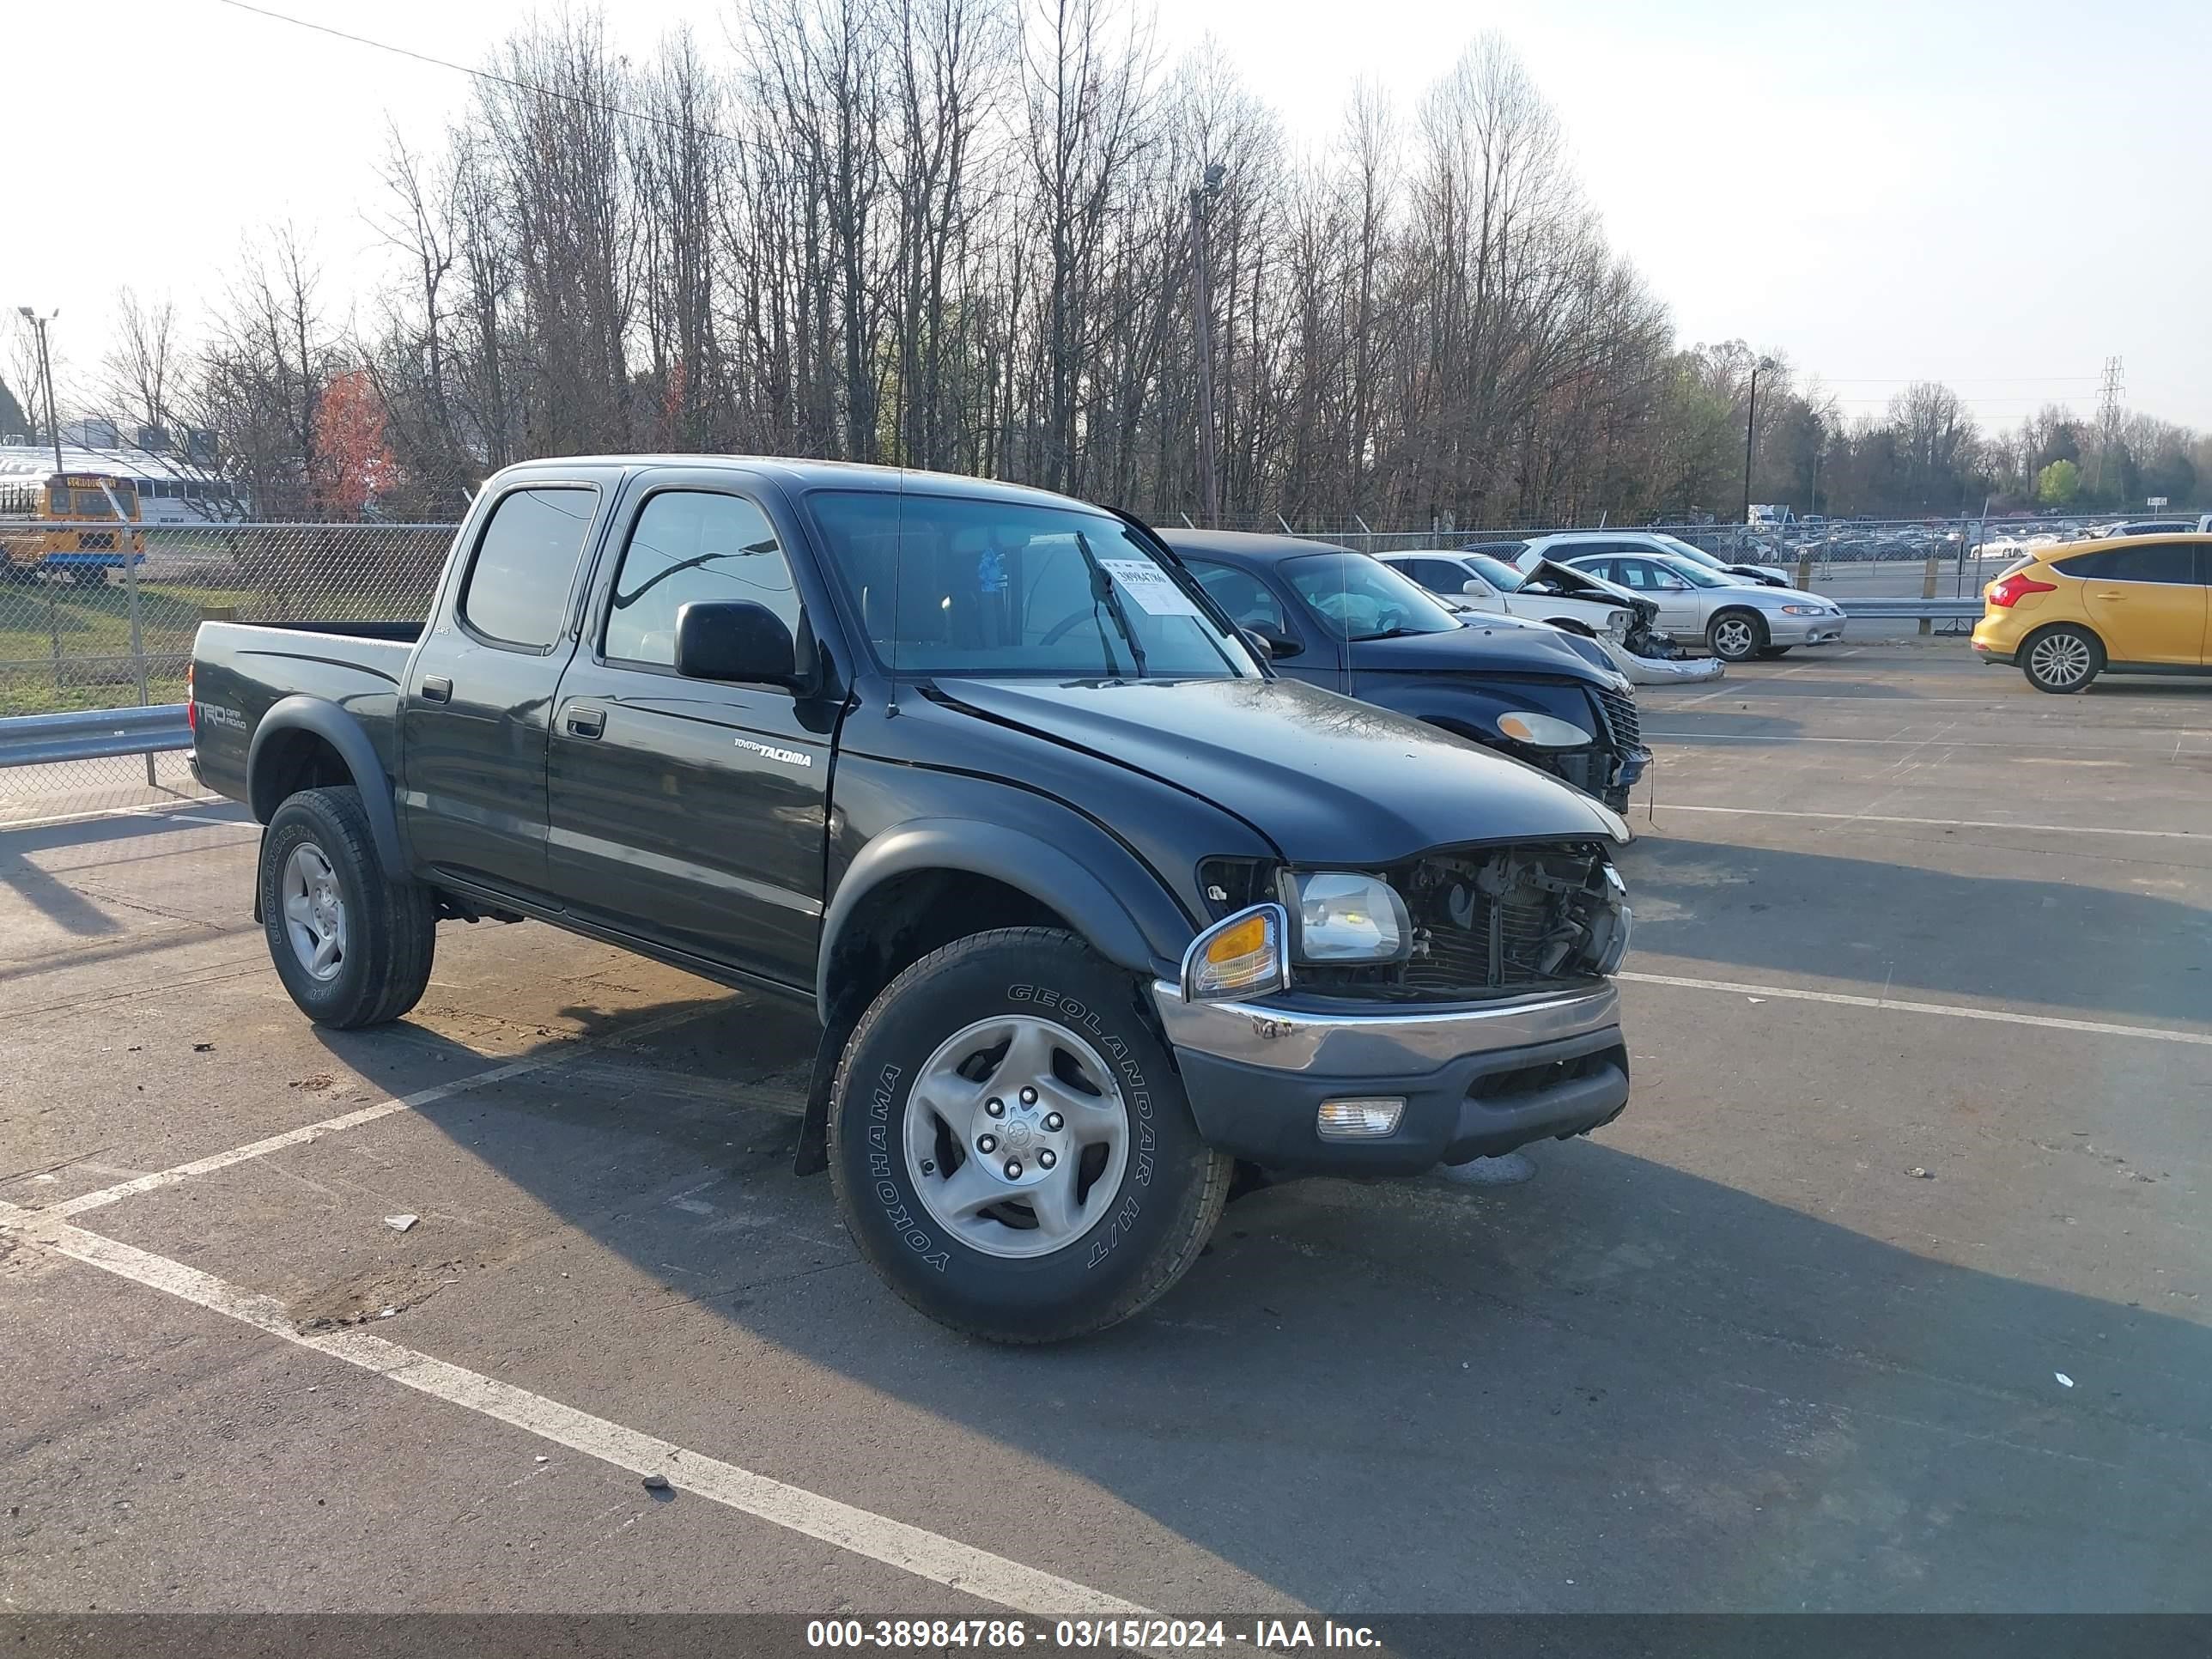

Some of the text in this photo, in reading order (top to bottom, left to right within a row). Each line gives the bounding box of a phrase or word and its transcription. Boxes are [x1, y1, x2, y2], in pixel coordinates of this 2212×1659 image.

[194, 701, 226, 726] TRD
[226, 717, 247, 728] ROAD
[734, 738, 812, 767] TOYOTA TACOMA
[1006, 983, 1157, 1269] GEOLANDAR H/T
[867, 1063, 951, 1273] YOKOHAMA
